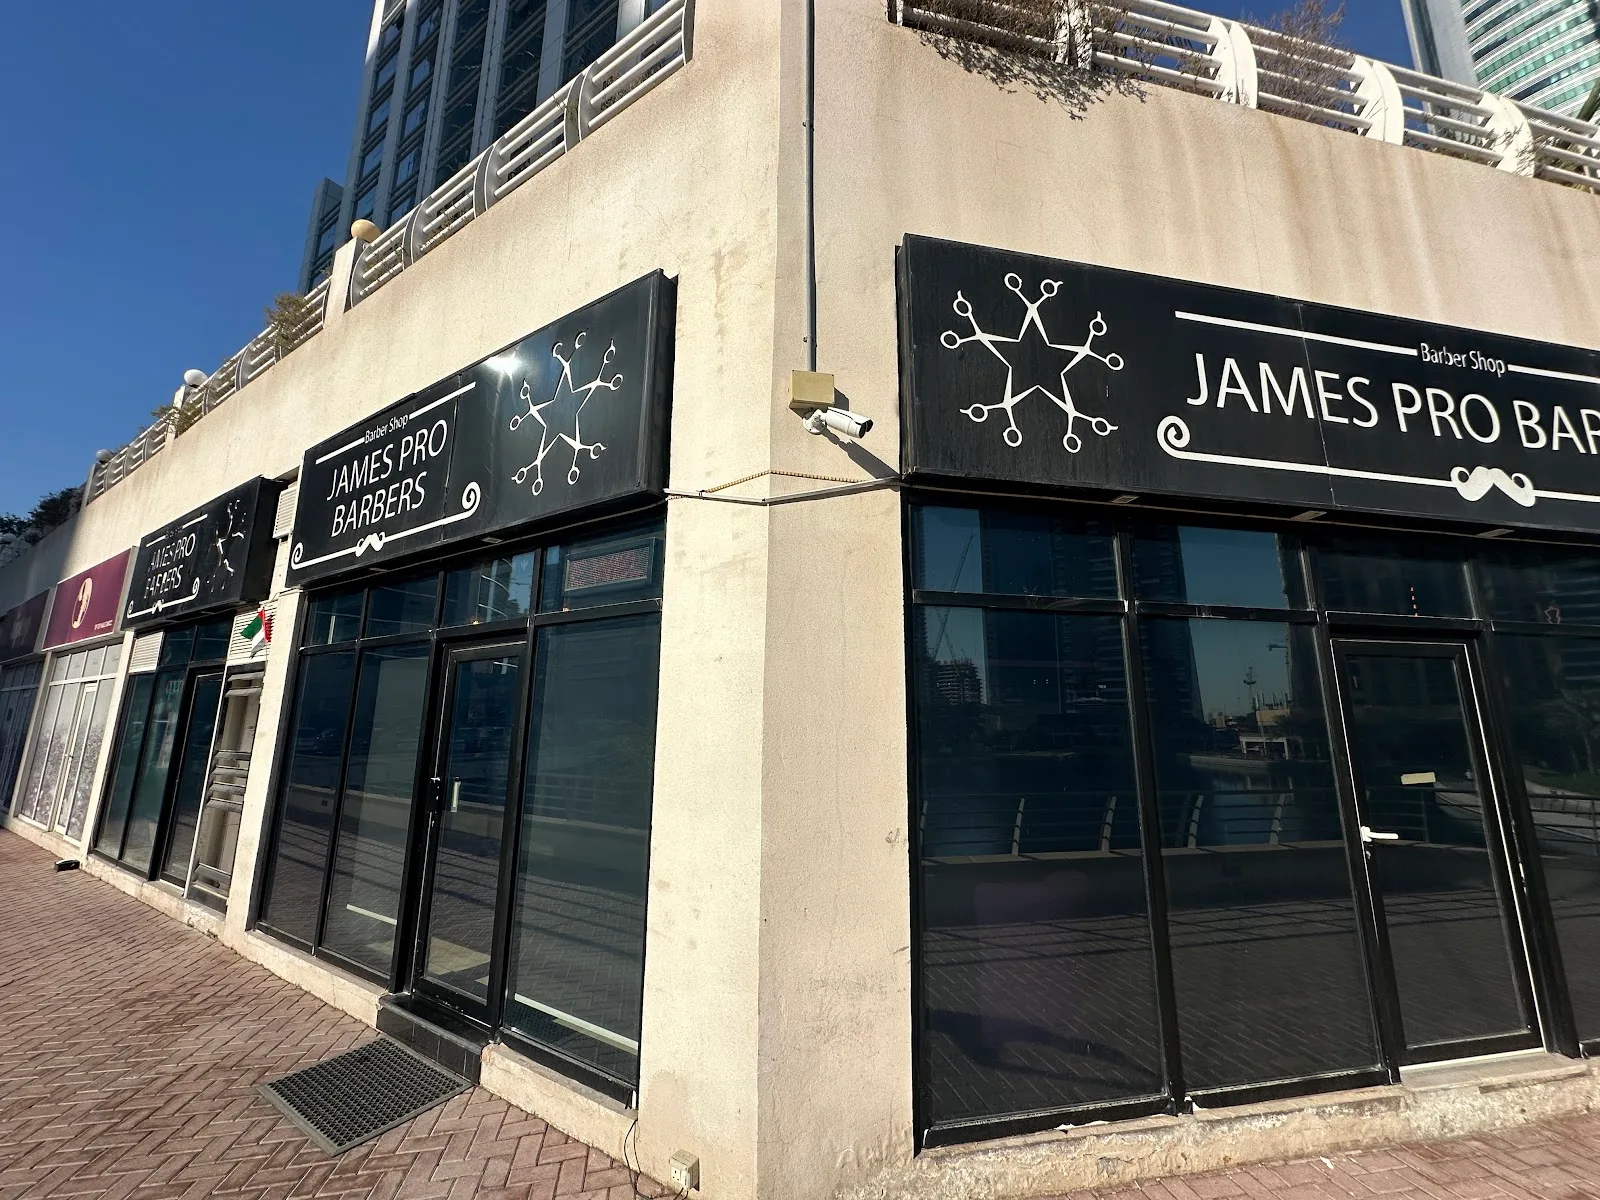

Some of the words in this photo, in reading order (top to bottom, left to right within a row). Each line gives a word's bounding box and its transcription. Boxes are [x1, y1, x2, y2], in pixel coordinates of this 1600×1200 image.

[1420, 342, 1467, 368] Barber
[1469, 350, 1506, 378] Shop
[1186, 352, 1380, 429] JAMES
[1391, 382, 1501, 444] PRO
[364, 424, 388, 444] Barber
[388, 414, 409, 433] Shop
[326, 443, 394, 502] JAMES
[398, 419, 448, 472] PRO
[331, 471, 428, 538] BARBERS
[173, 532, 196, 562] PRO
